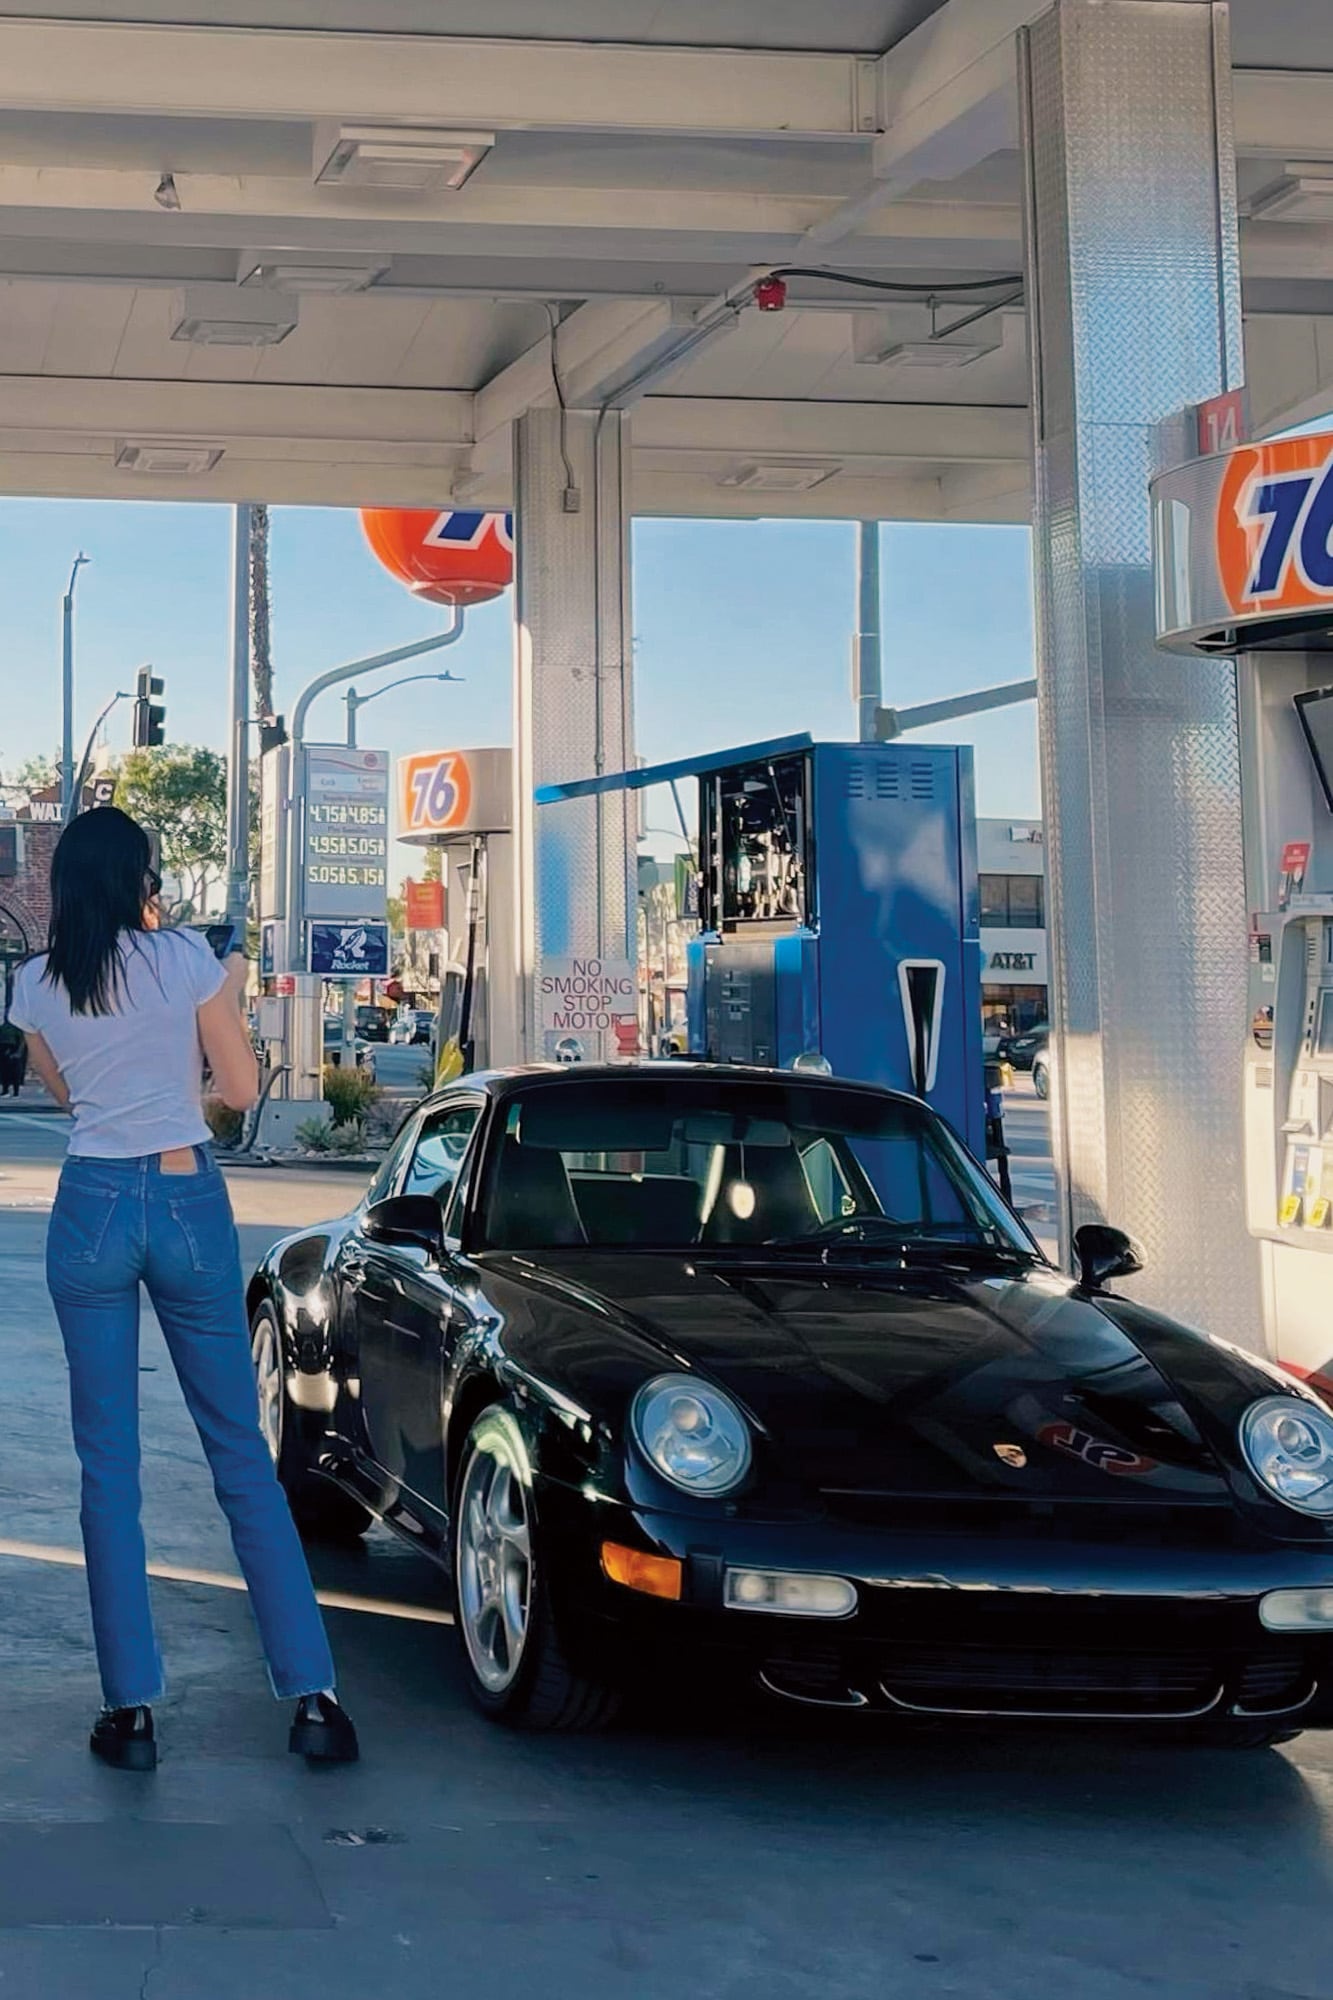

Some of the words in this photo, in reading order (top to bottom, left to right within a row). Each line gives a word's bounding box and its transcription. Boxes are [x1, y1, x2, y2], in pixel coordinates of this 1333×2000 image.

[1206, 405, 1239, 453] 14
[411, 758, 459, 827] 76
[331, 959, 370, 971] Rocket
[573, 960, 602, 977] NO
[990, 953, 1037, 971] AT&T
[541, 976, 633, 995] SMOKING
[563, 995, 612, 1012] STOP
[553, 1012, 620, 1030] MOTOR
